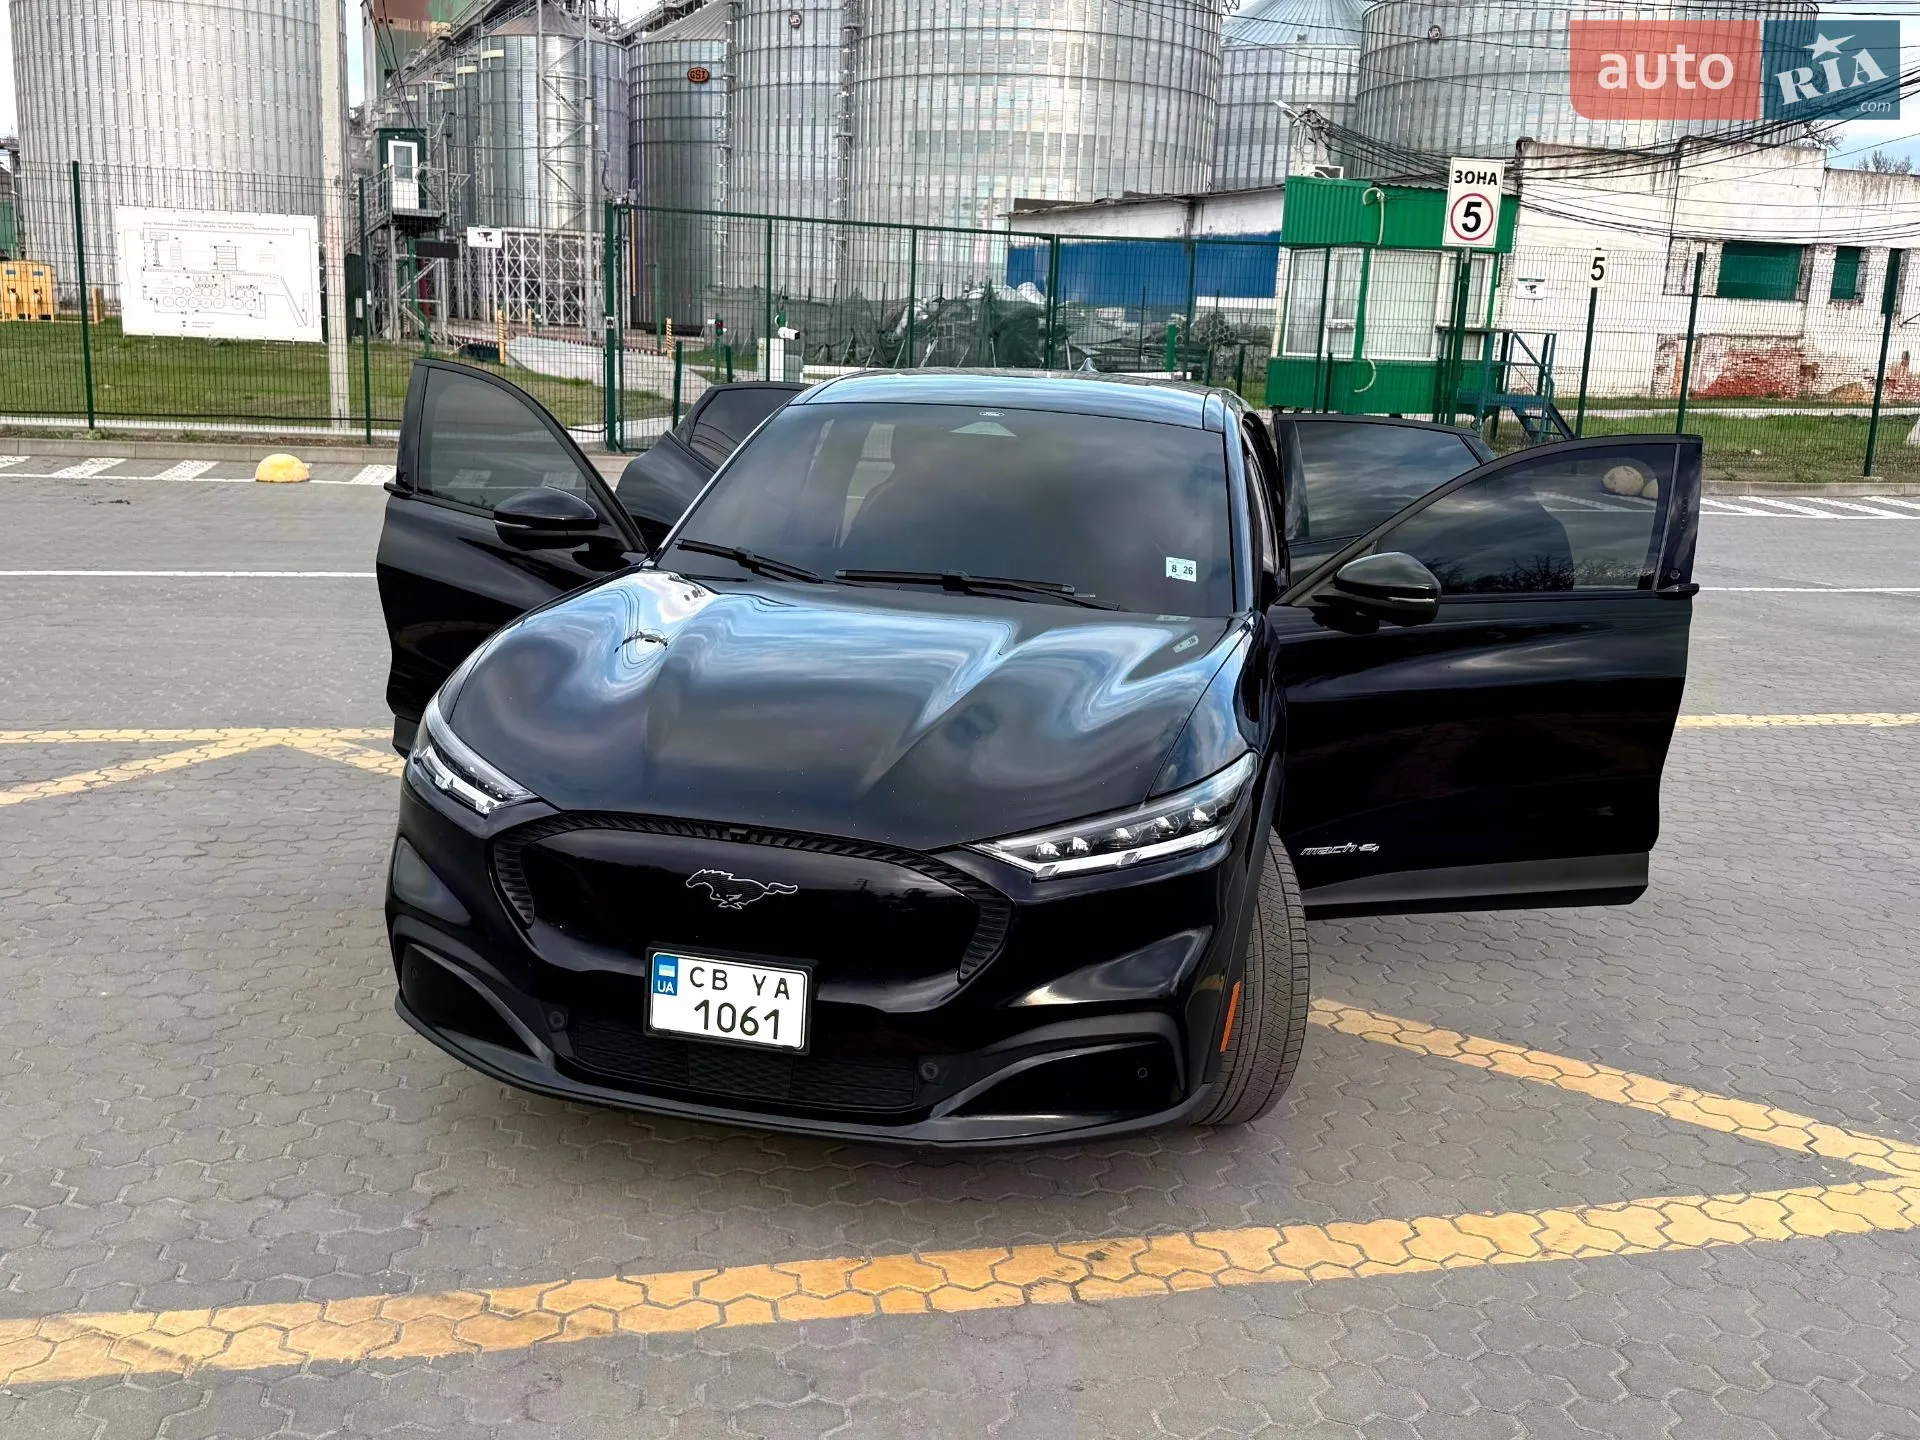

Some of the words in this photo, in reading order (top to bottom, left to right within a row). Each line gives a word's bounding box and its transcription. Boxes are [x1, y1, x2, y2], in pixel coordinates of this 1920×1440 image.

[690, 69, 706, 80] GSI
[1454, 170, 1498, 186] ЗОНА
[1462, 201, 1482, 232] 5
[1590, 256, 1605, 281] 5
[1171, 564, 1177, 573] 8
[1183, 565, 1194, 575] 26
[657, 981, 674, 994] UA
[689, 966, 728, 991] CB
[752, 974, 790, 1000] YA
[694, 999, 780, 1040] 1061
